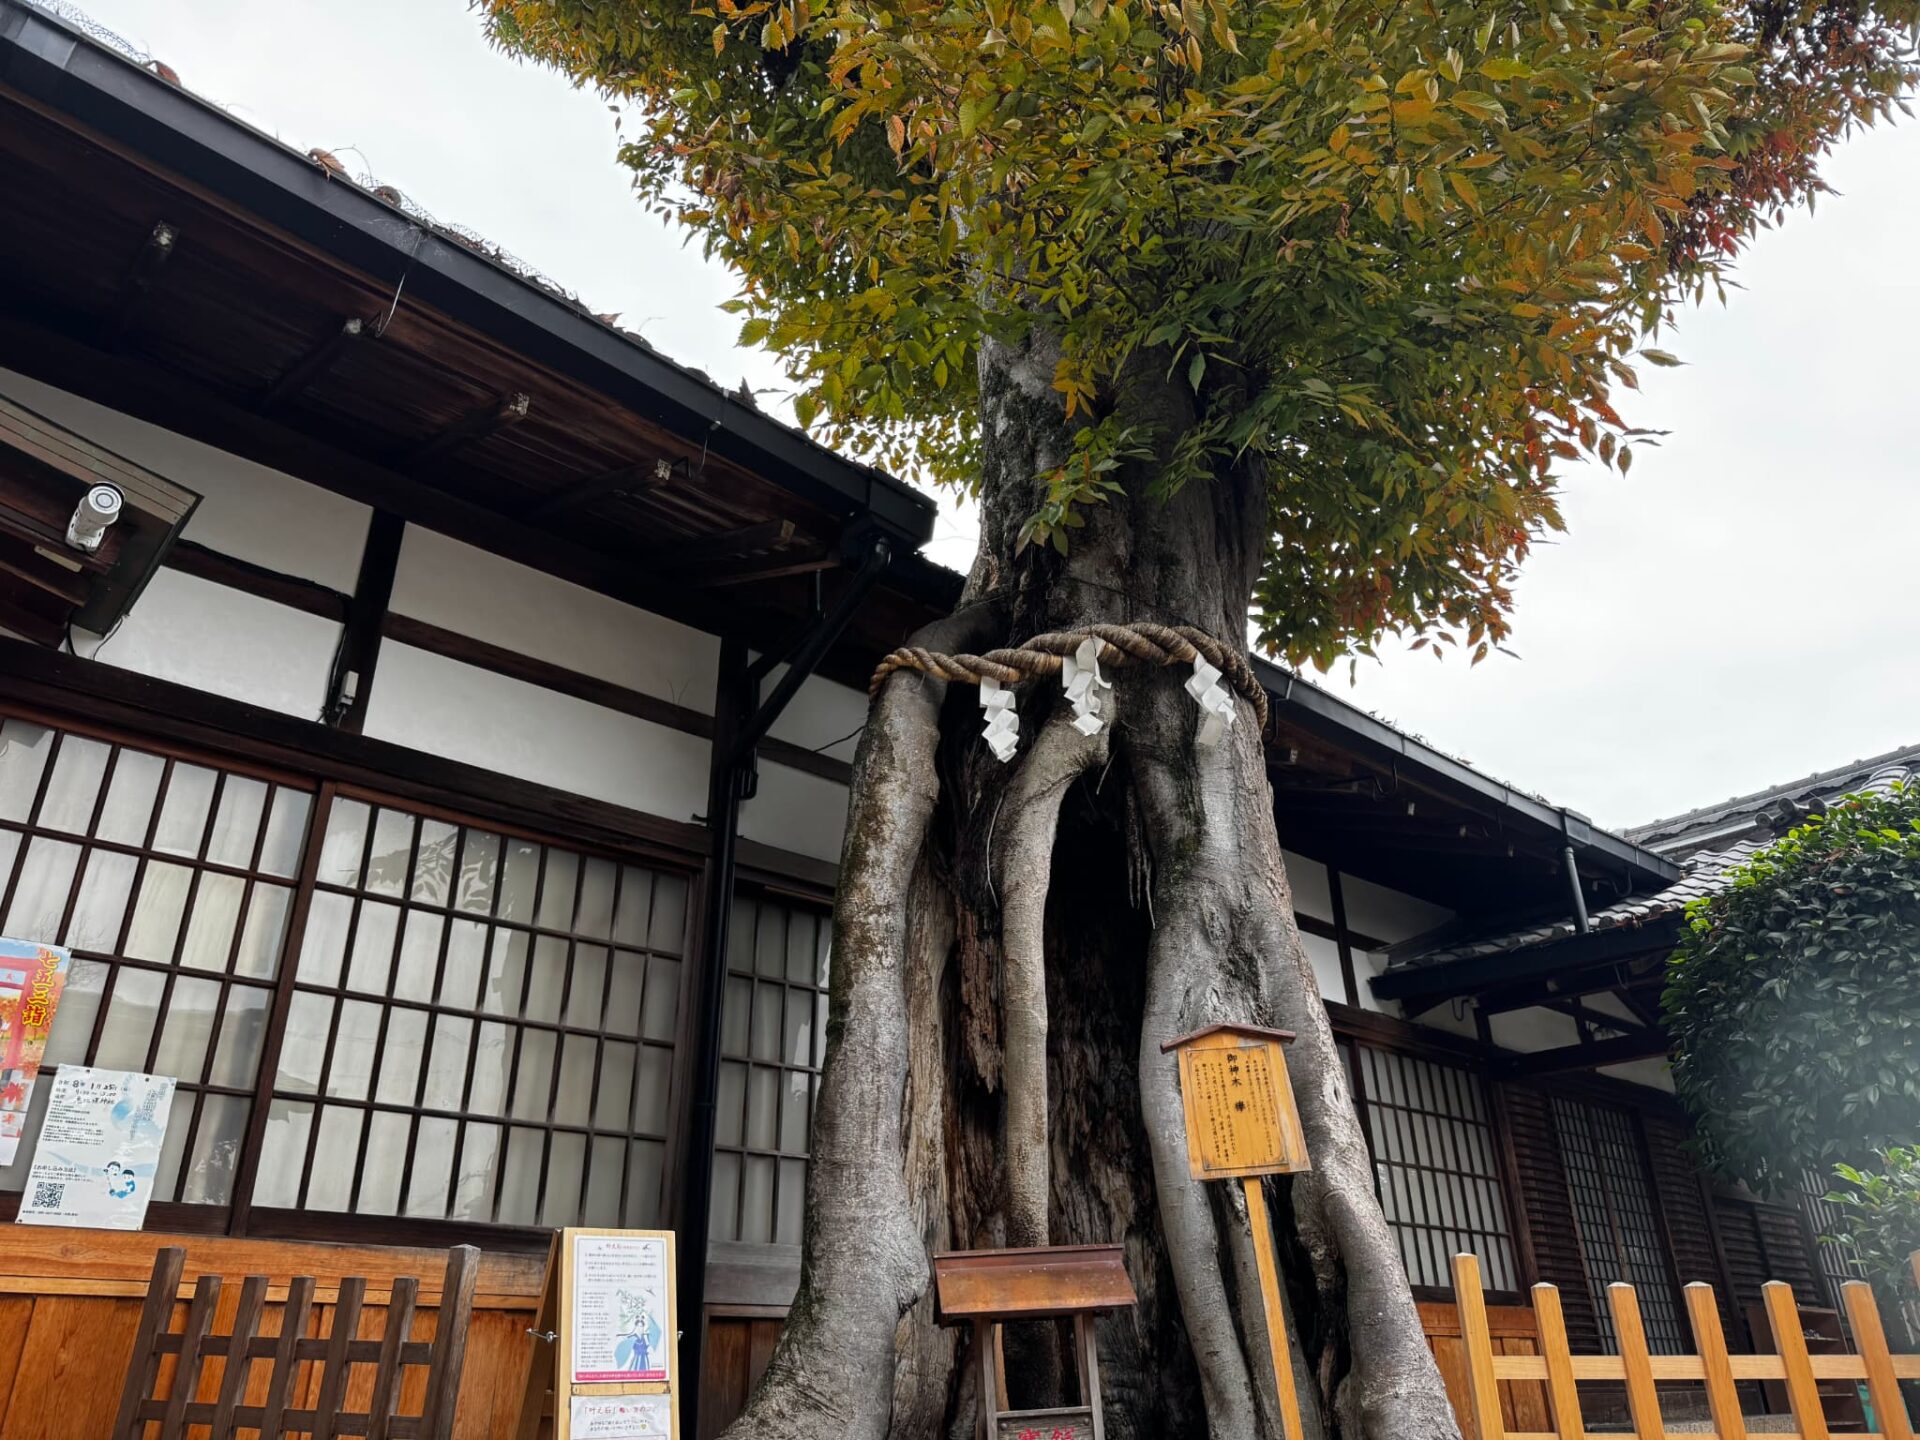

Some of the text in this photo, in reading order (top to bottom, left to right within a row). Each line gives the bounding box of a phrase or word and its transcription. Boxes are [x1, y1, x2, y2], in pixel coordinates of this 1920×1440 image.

[22, 949, 61, 1027] 七五三詣
[1227, 1053, 1242, 1087] 御神木
